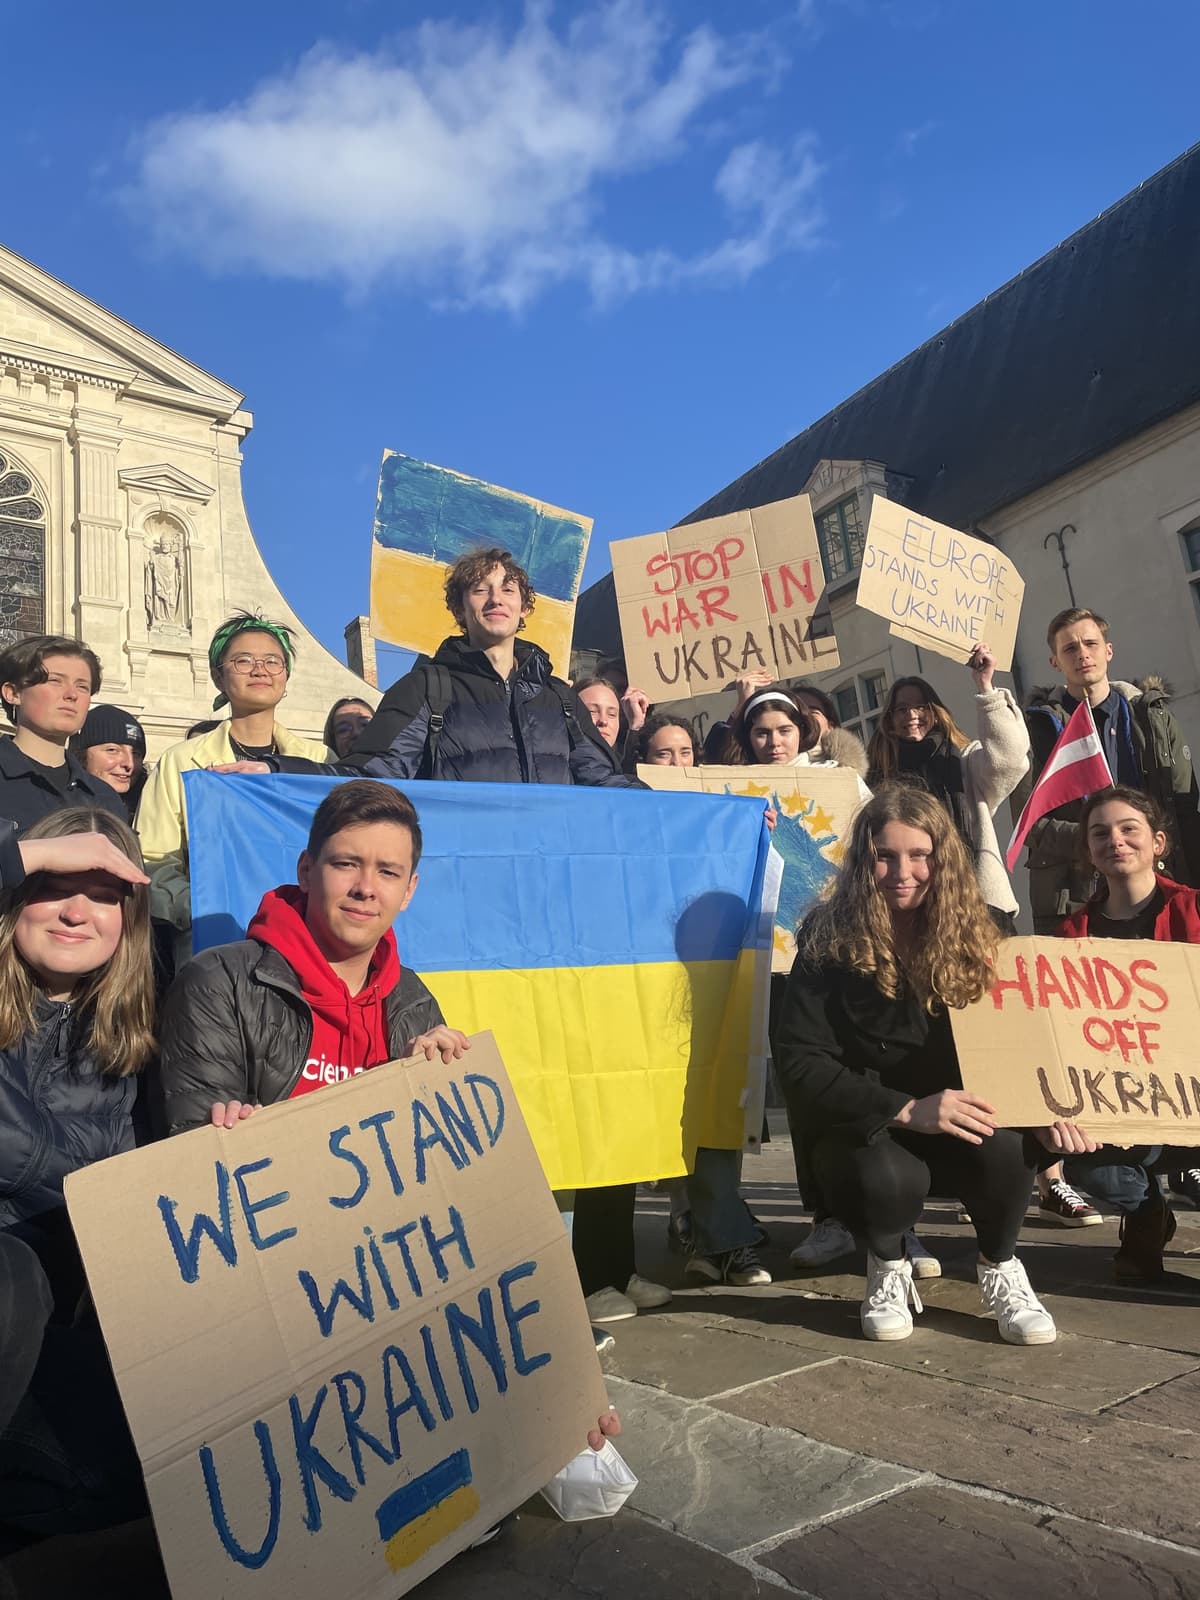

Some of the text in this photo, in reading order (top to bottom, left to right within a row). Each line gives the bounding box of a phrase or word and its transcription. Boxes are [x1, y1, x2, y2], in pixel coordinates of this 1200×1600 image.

[646, 538, 744, 595] STOP
[865, 545, 1004, 626] STANDS WITH
[902, 518, 1008, 601] EUROPE
[642, 559, 816, 638] WAR IN
[891, 588, 982, 641] UKRAINE
[653, 616, 838, 684] UKRAINE
[985, 953, 1169, 1013] HANDS
[1082, 1016, 1161, 1065] OFF
[157, 1073, 506, 1283] WE STAND
[199, 1261, 552, 1569] UKRAINE
